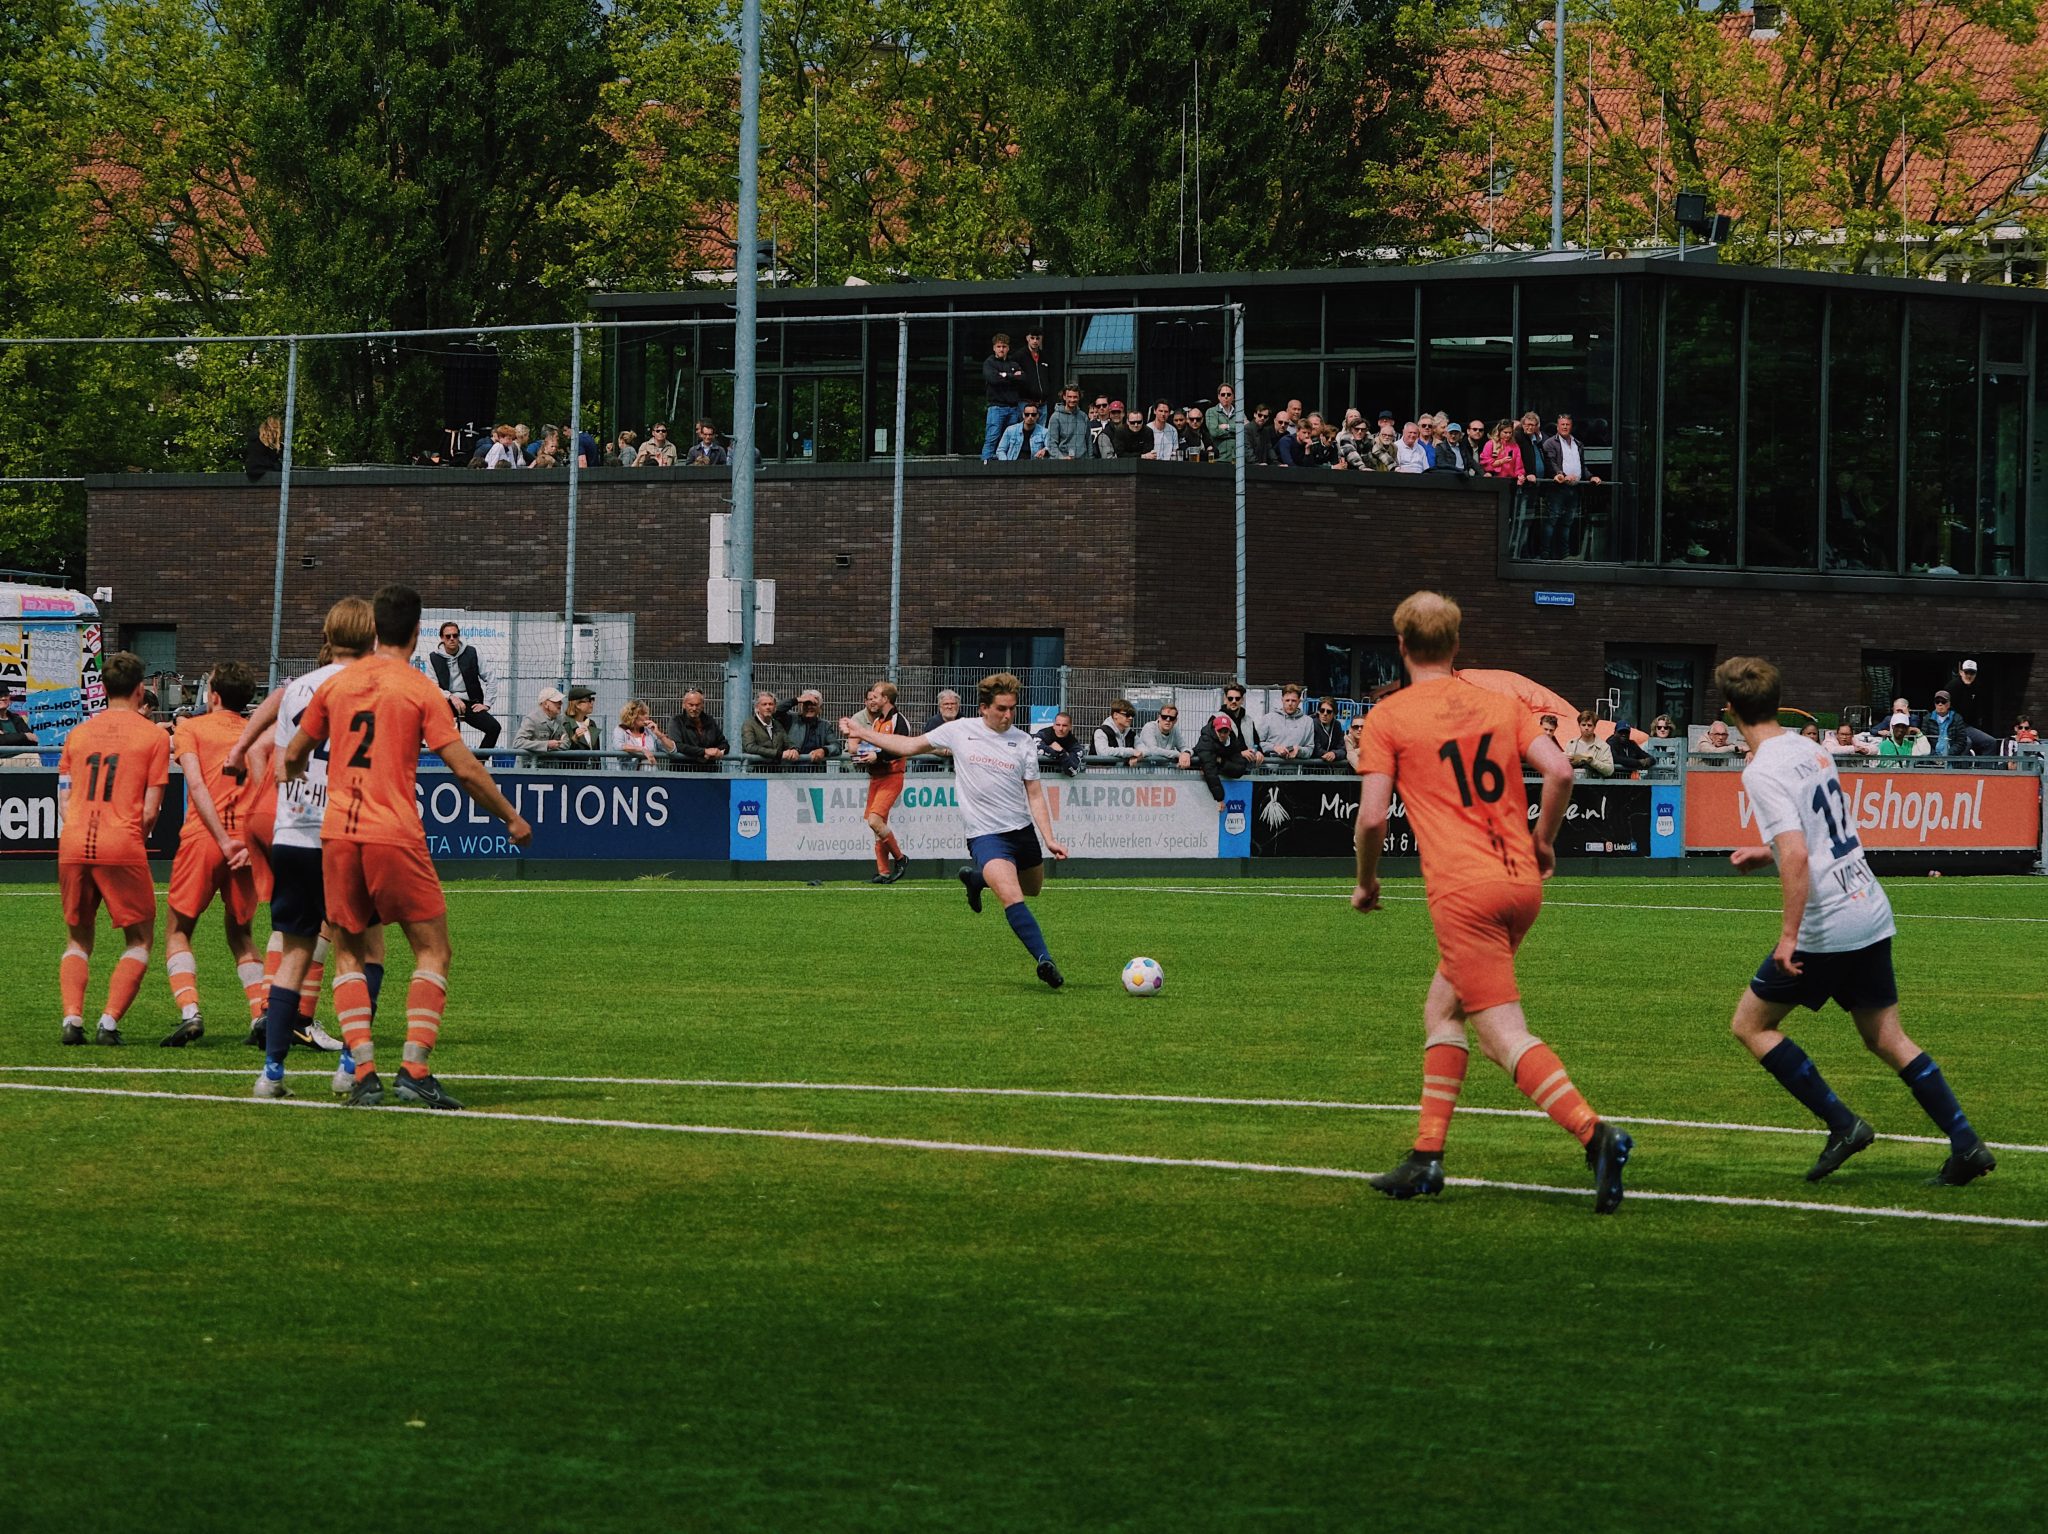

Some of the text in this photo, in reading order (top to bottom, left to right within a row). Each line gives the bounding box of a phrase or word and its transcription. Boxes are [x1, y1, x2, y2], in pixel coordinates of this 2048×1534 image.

[347, 710, 376, 769] 2
[86, 752, 119, 802] 11
[1439, 731, 1505, 808] 16
[830, 786, 959, 809] ALPGOAL
[1066, 786, 1177, 807] ALPRONED
[889, 814, 963, 823] EQUIPMEN
[459, 835, 521, 854] WORK
[806, 834, 871, 855] wavegoals
[926, 833, 967, 854] special
[1088, 832, 1151, 848] hekwerken
[1163, 832, 1208, 852] specials
